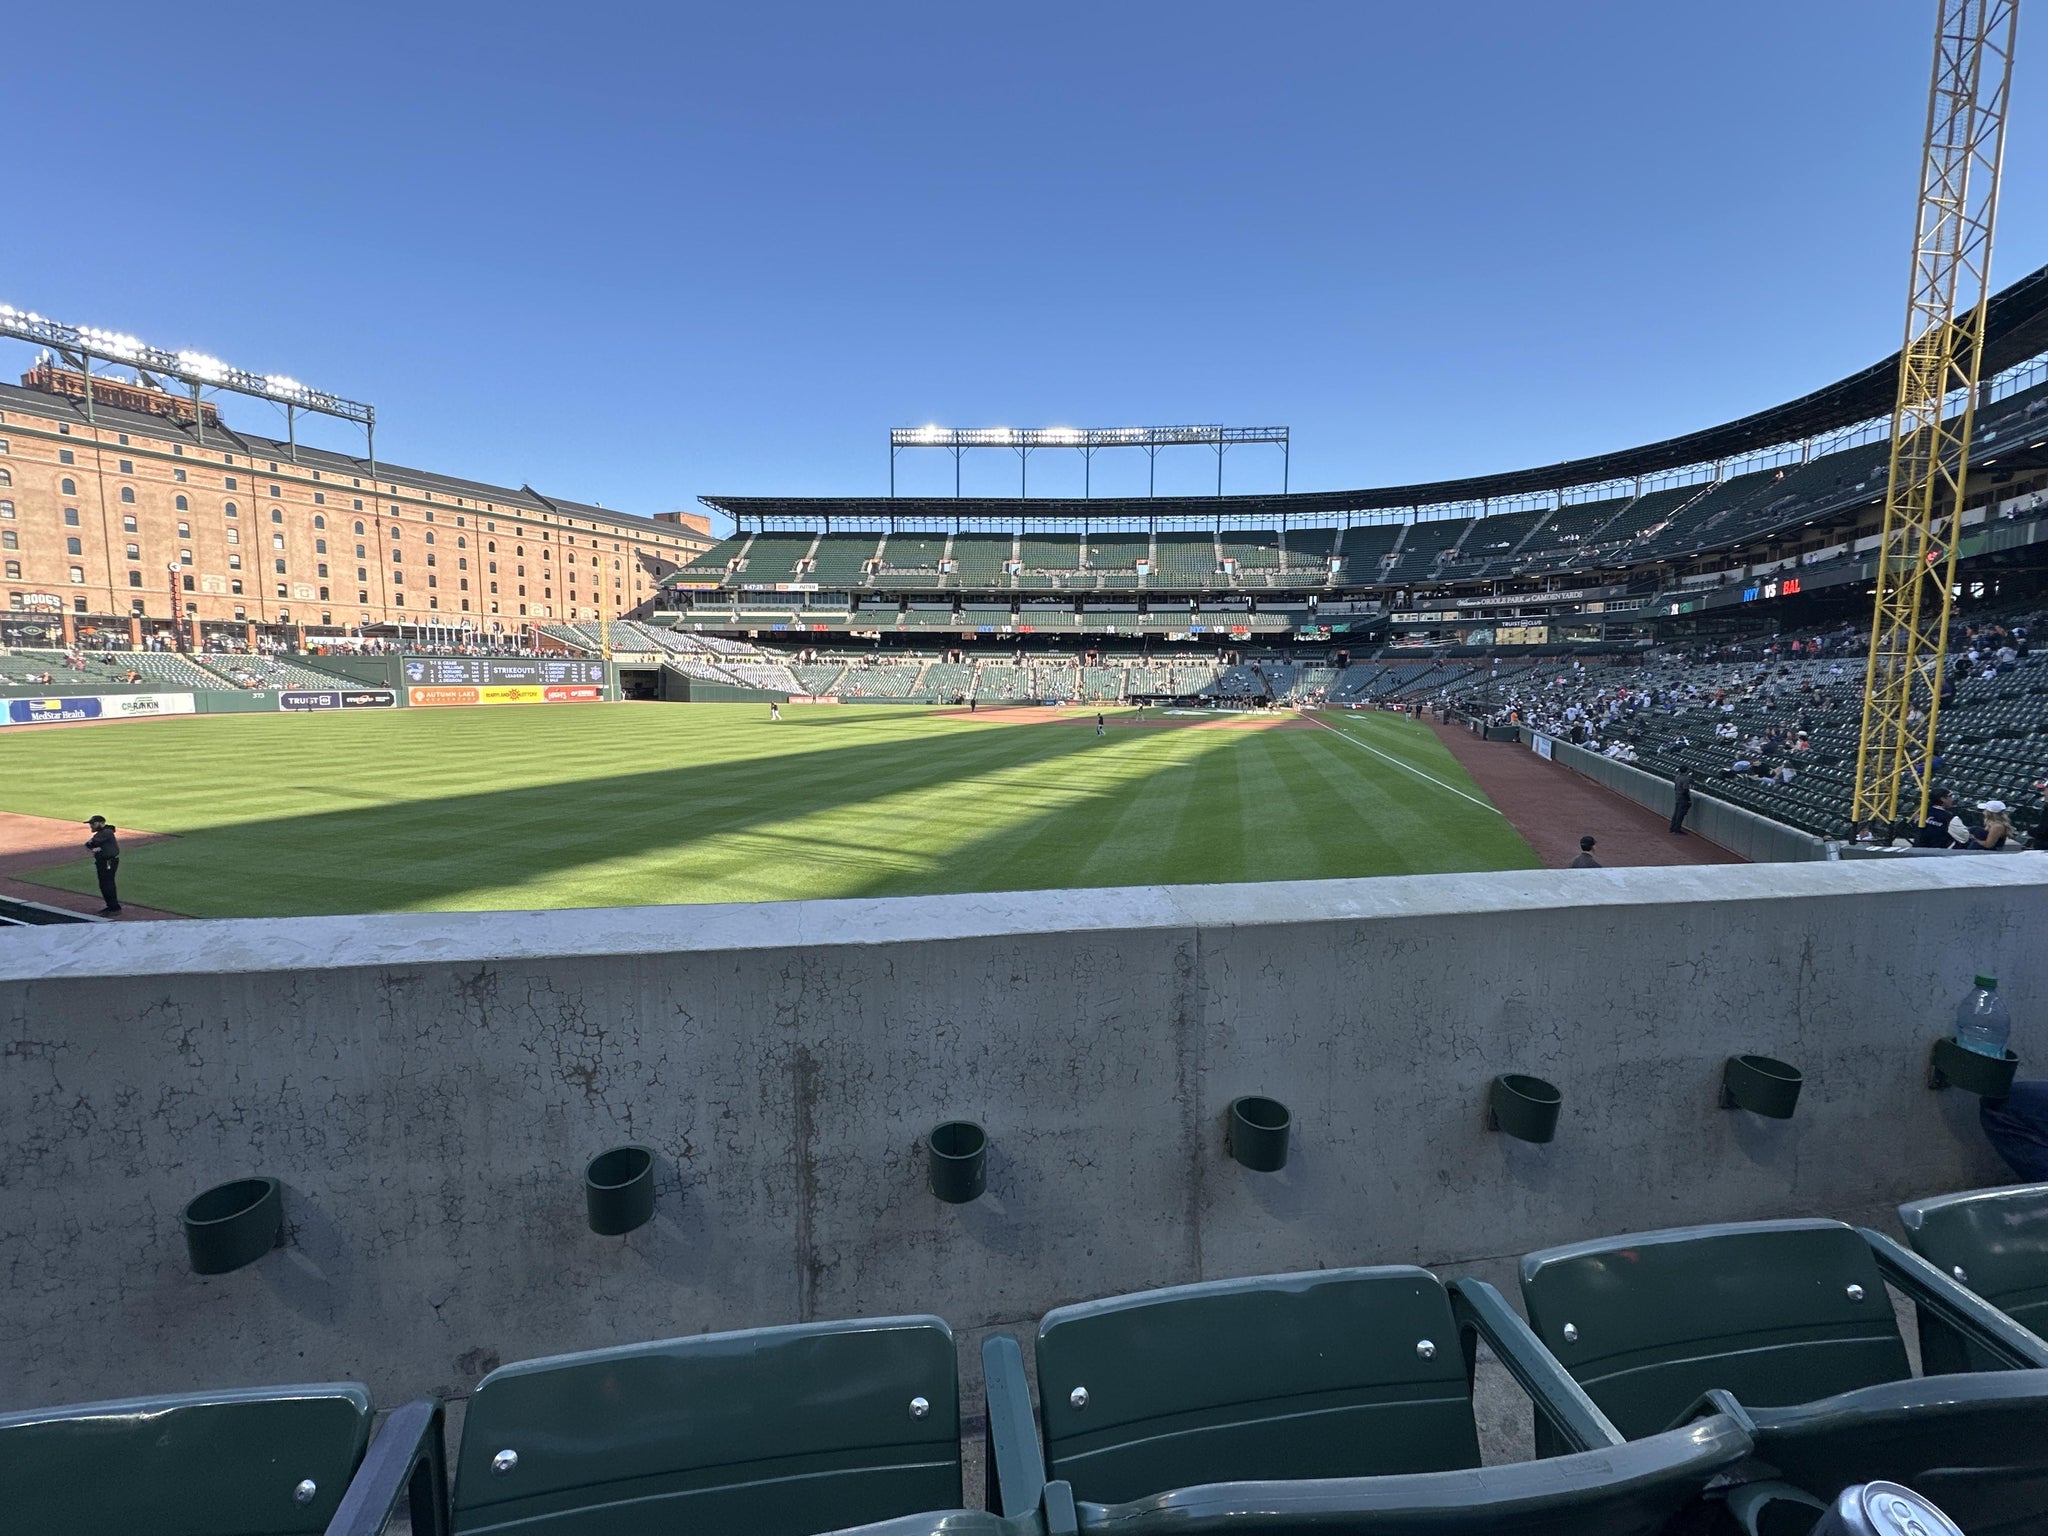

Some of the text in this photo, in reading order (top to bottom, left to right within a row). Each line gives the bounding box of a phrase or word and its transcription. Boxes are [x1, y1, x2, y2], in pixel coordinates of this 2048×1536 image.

[1764, 583, 1777, 599] VS
[1782, 579, 1800, 595] BAL
[1481, 597, 1506, 605] ORIOLE
[1531, 592, 1560, 602] CAMDEN
[1561, 590, 1583, 599] YARDS
[31, 709, 86, 720] MedStar Health
